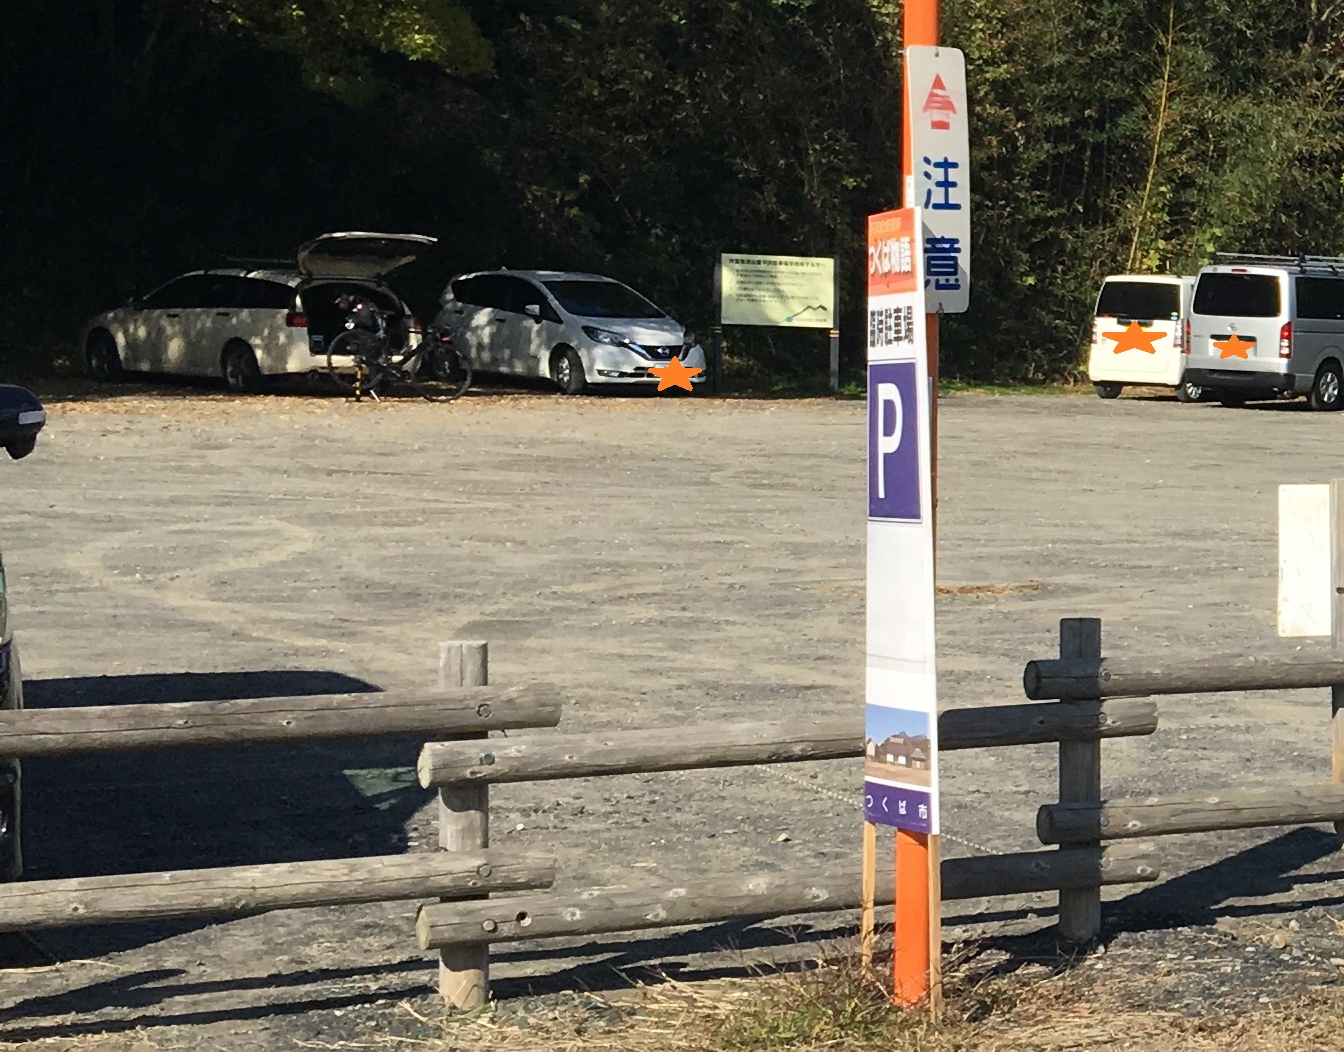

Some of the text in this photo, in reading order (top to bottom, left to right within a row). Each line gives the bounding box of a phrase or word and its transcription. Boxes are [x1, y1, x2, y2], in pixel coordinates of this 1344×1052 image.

[868, 236, 912, 275] つくば物語
[922, 155, 962, 292] 注意
[877, 382, 903, 499] P
[865, 794, 928, 820] つくば市
